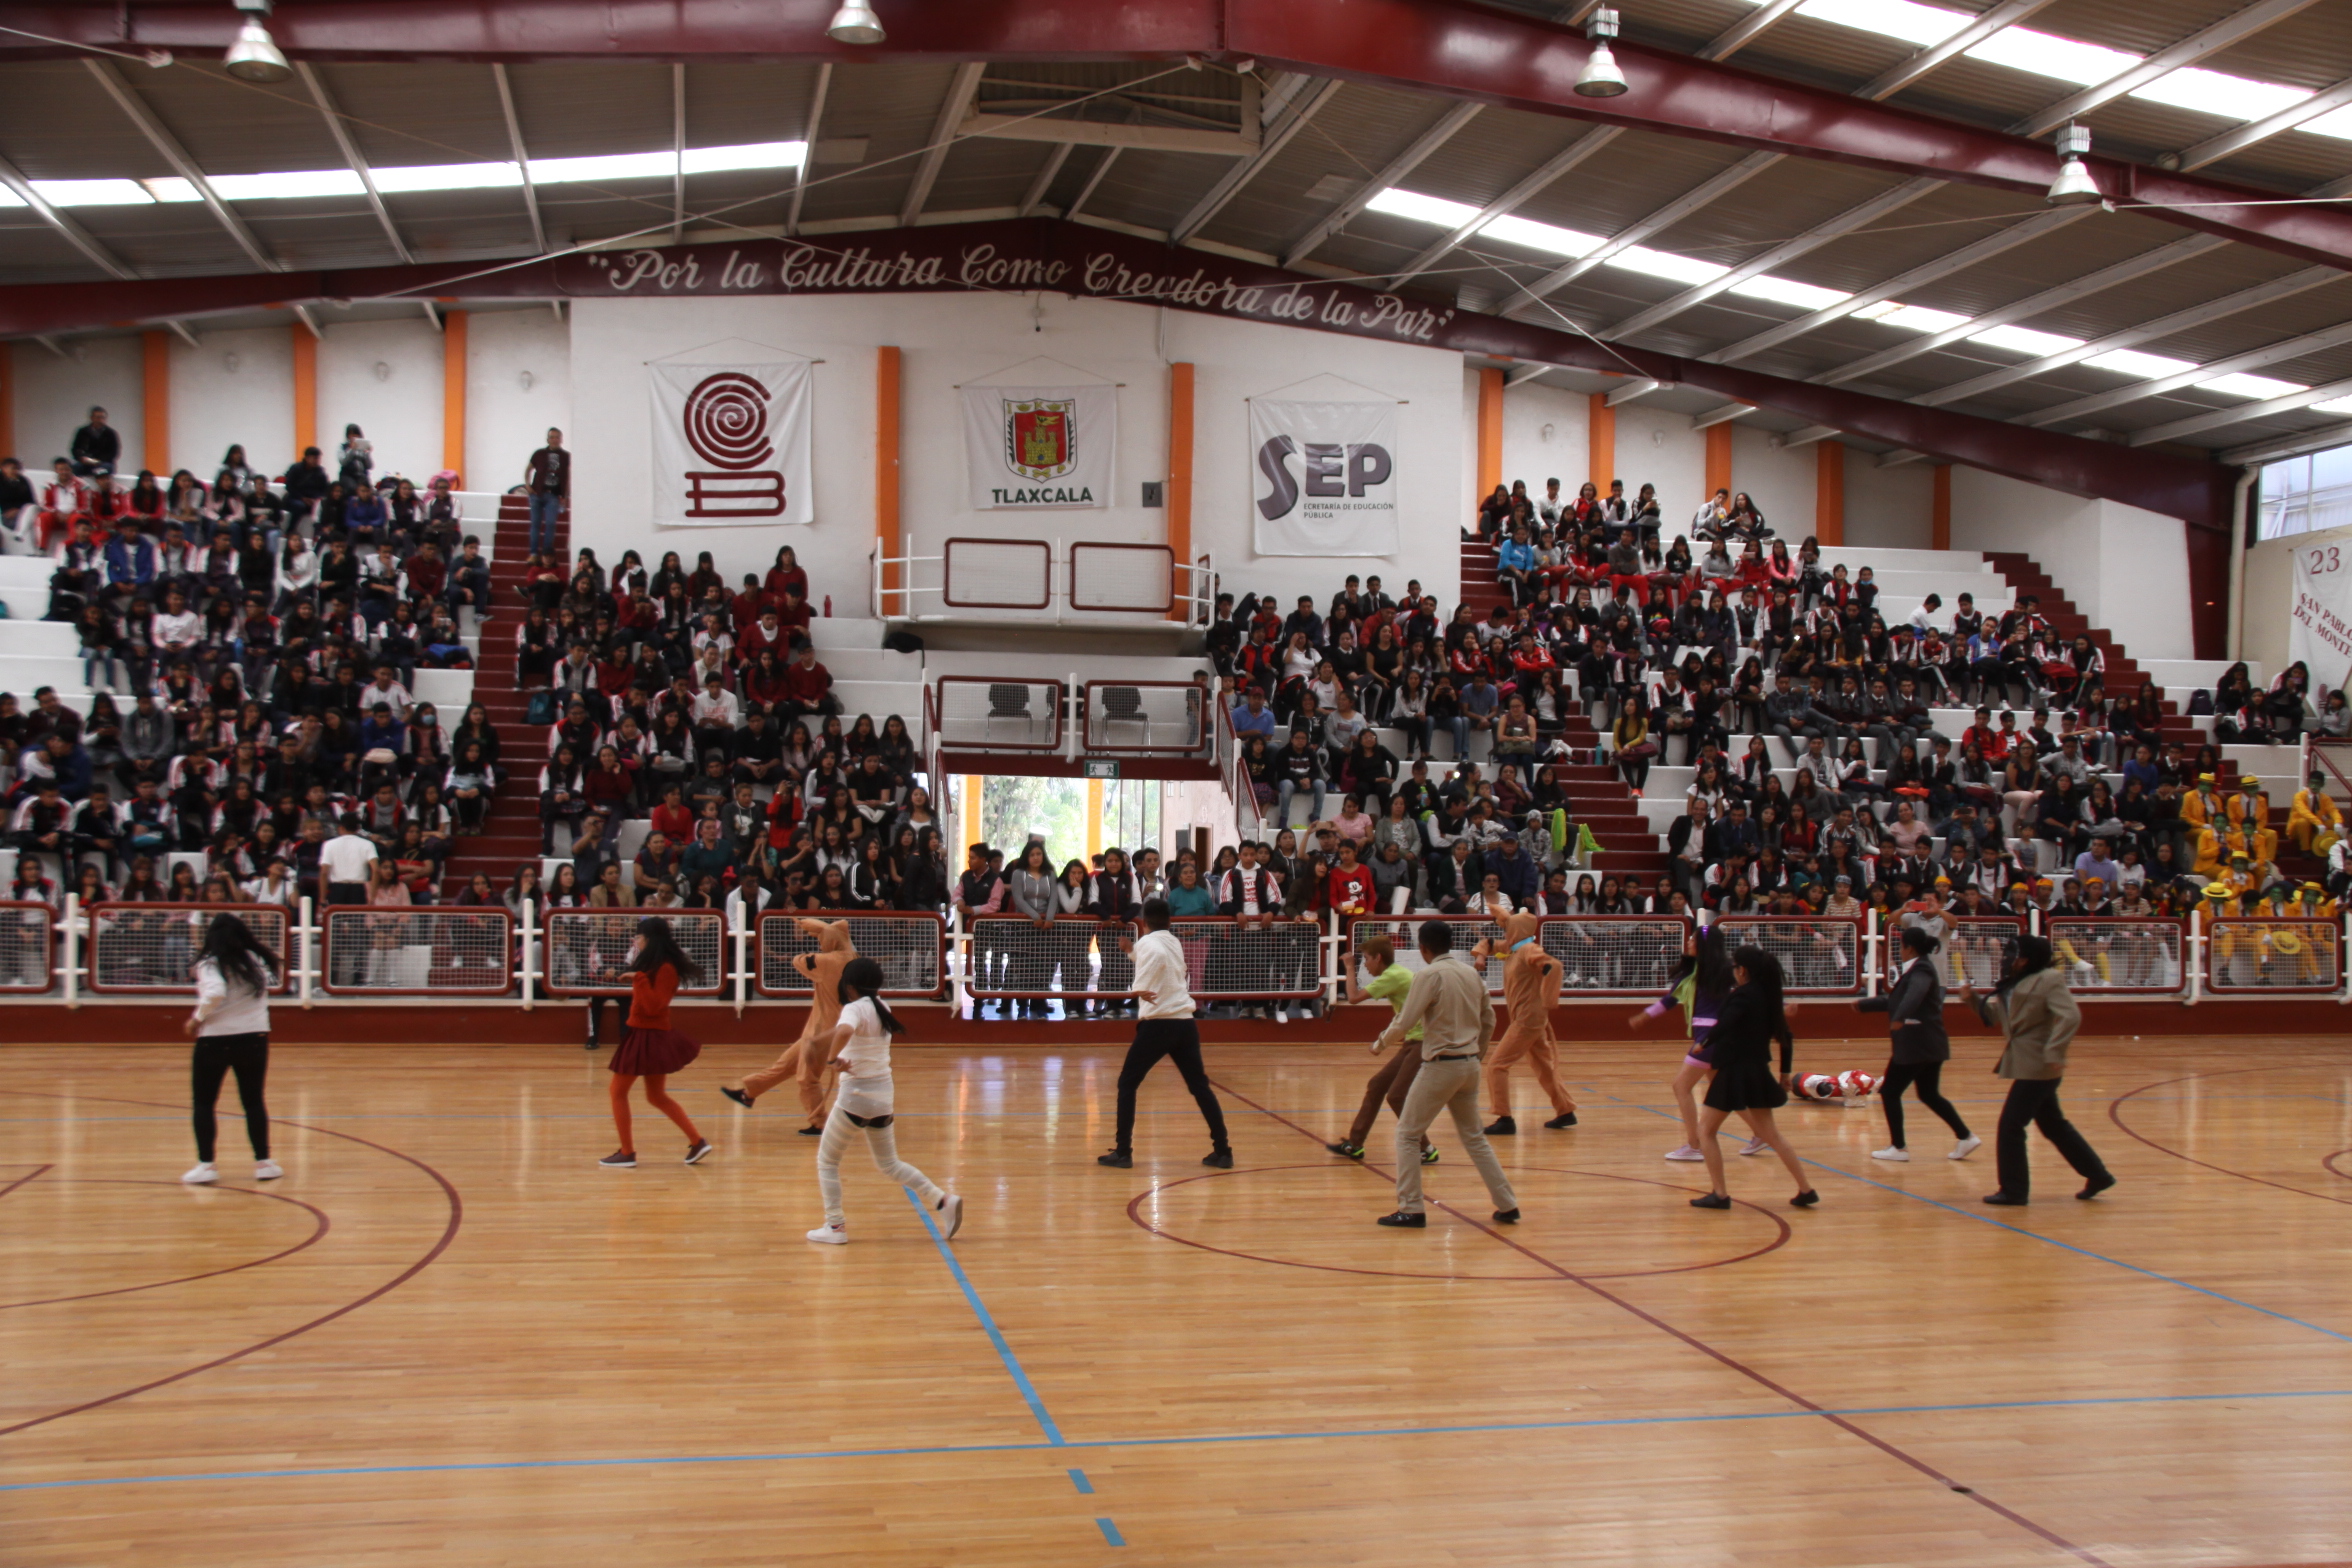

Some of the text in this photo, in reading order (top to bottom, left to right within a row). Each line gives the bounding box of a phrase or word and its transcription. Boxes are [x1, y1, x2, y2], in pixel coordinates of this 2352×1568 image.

[720, 250, 764, 289] la
[781, 247, 946, 290] Cultura
[961, 244, 1073, 286] Como
[1271, 283, 1315, 320] de
[1320, 289, 1354, 326] la
[1257, 434, 1392, 521] SEP
[992, 487, 1093, 503] TLAXCALA
[1353, 502, 1394, 510] EDUCACIÓN
[1303, 510, 1334, 518] PÚBLICA
[2310, 547, 2340, 575] 23
[2300, 592, 2322, 615] SAN
[2293, 604, 2352, 658] DEL MONTE
